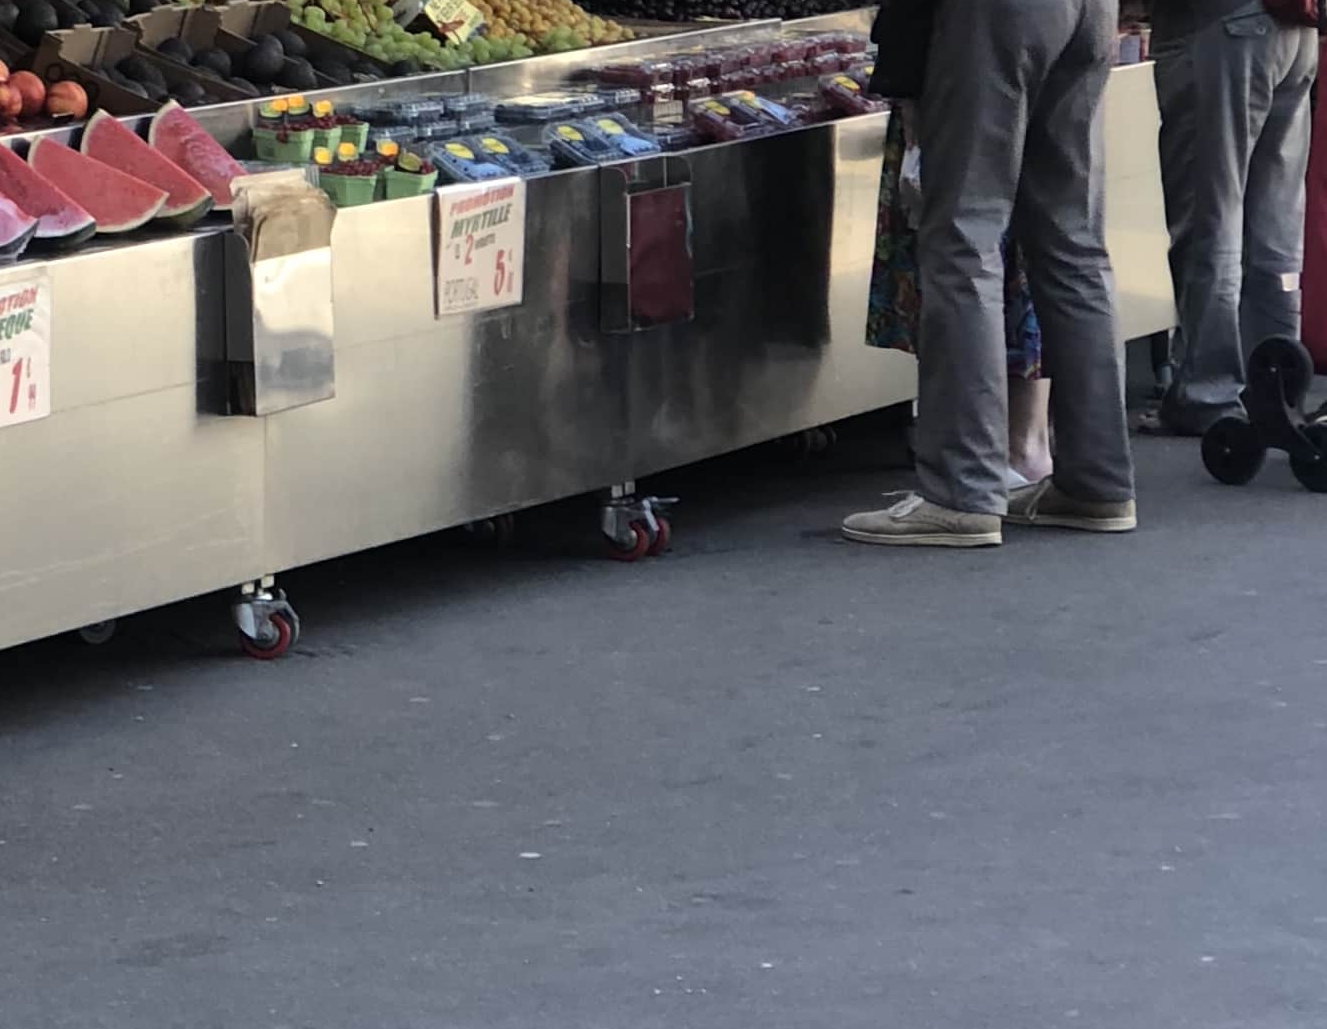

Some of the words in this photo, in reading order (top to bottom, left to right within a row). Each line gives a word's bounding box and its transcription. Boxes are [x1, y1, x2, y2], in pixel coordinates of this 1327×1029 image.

[450, 204, 512, 239] MYRTILLE
[464, 234, 474, 266] 2
[9, 357, 23, 414] 1
